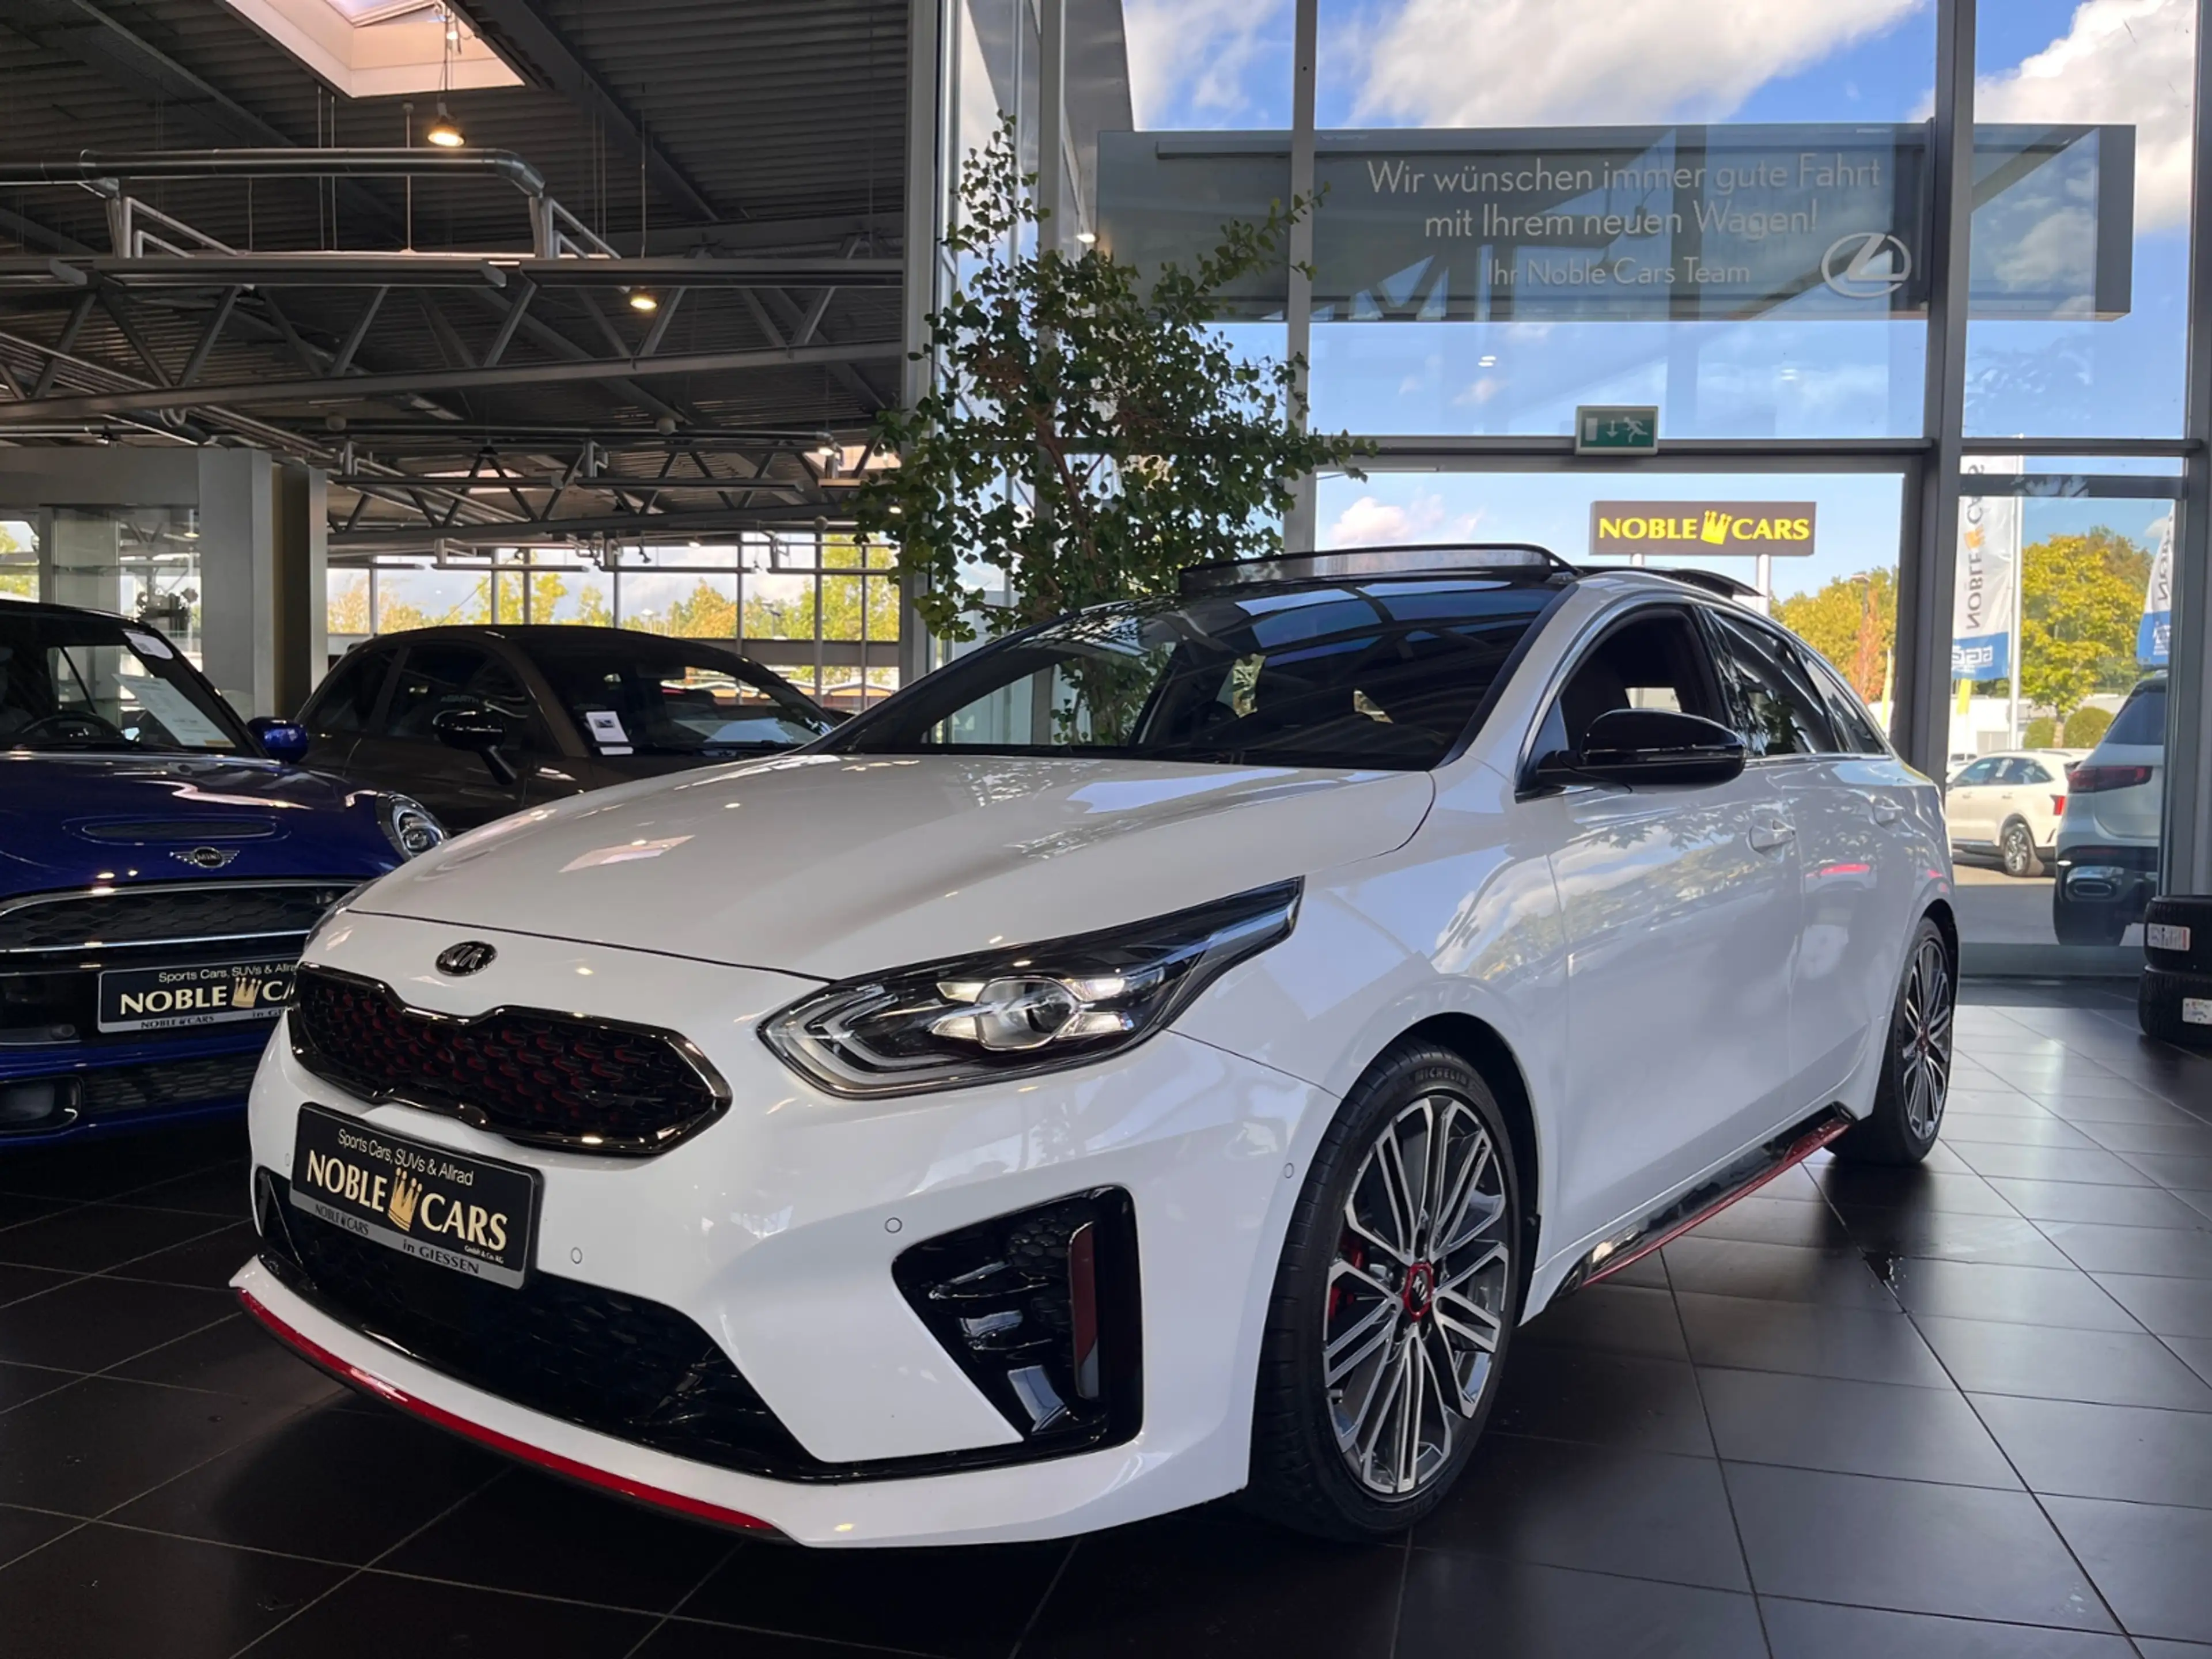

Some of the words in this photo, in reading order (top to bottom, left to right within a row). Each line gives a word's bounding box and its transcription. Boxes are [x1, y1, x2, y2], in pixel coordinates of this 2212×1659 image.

[1368, 161, 1425, 194] Wir
[1434, 158, 1593, 192] wünschen
[1603, 160, 1706, 190] immer
[1716, 160, 1787, 195] gute
[1798, 153, 1881, 188] Fahrt
[1425, 210, 1473, 237] mit
[1483, 203, 1574, 237] Ihrem
[1585, 215, 1682, 235] neuen
[1693, 199, 1818, 243] Wagen!
[1487, 259, 1517, 286] Ihr
[1527, 258, 1607, 286] Noble
[1613, 257, 1676, 285] Cars
[1683, 256, 1751, 284] Team
[1599, 517, 1697, 539] NOBLE
[1732, 518, 1810, 540] CARS
[158, 971, 197, 984] Sports
[200, 969, 230, 979] Cars,
[232, 967, 263, 977] SUVs
[264, 965, 272, 974] &
[275, 964, 297, 974] Allra
[120, 986, 227, 1015] NOBLE
[141, 1020, 176, 1029] NOBLE
[188, 1016, 214, 1025] CARS
[338, 1128, 368, 1153] Sports
[368, 1139, 393, 1165] Cars,
[395, 1148, 426, 1173] SUVs
[427, 1158, 437, 1175] &
[438, 1162, 474, 1185] Allrad
[306, 1149, 388, 1213] NOBLE
[420, 1192, 508, 1251] CARS
[315, 1204, 340, 1224] NOBLE
[346, 1217, 369, 1236] CARS
[403, 1239, 415, 1253] in
[419, 1247, 479, 1274] GIESSEN
